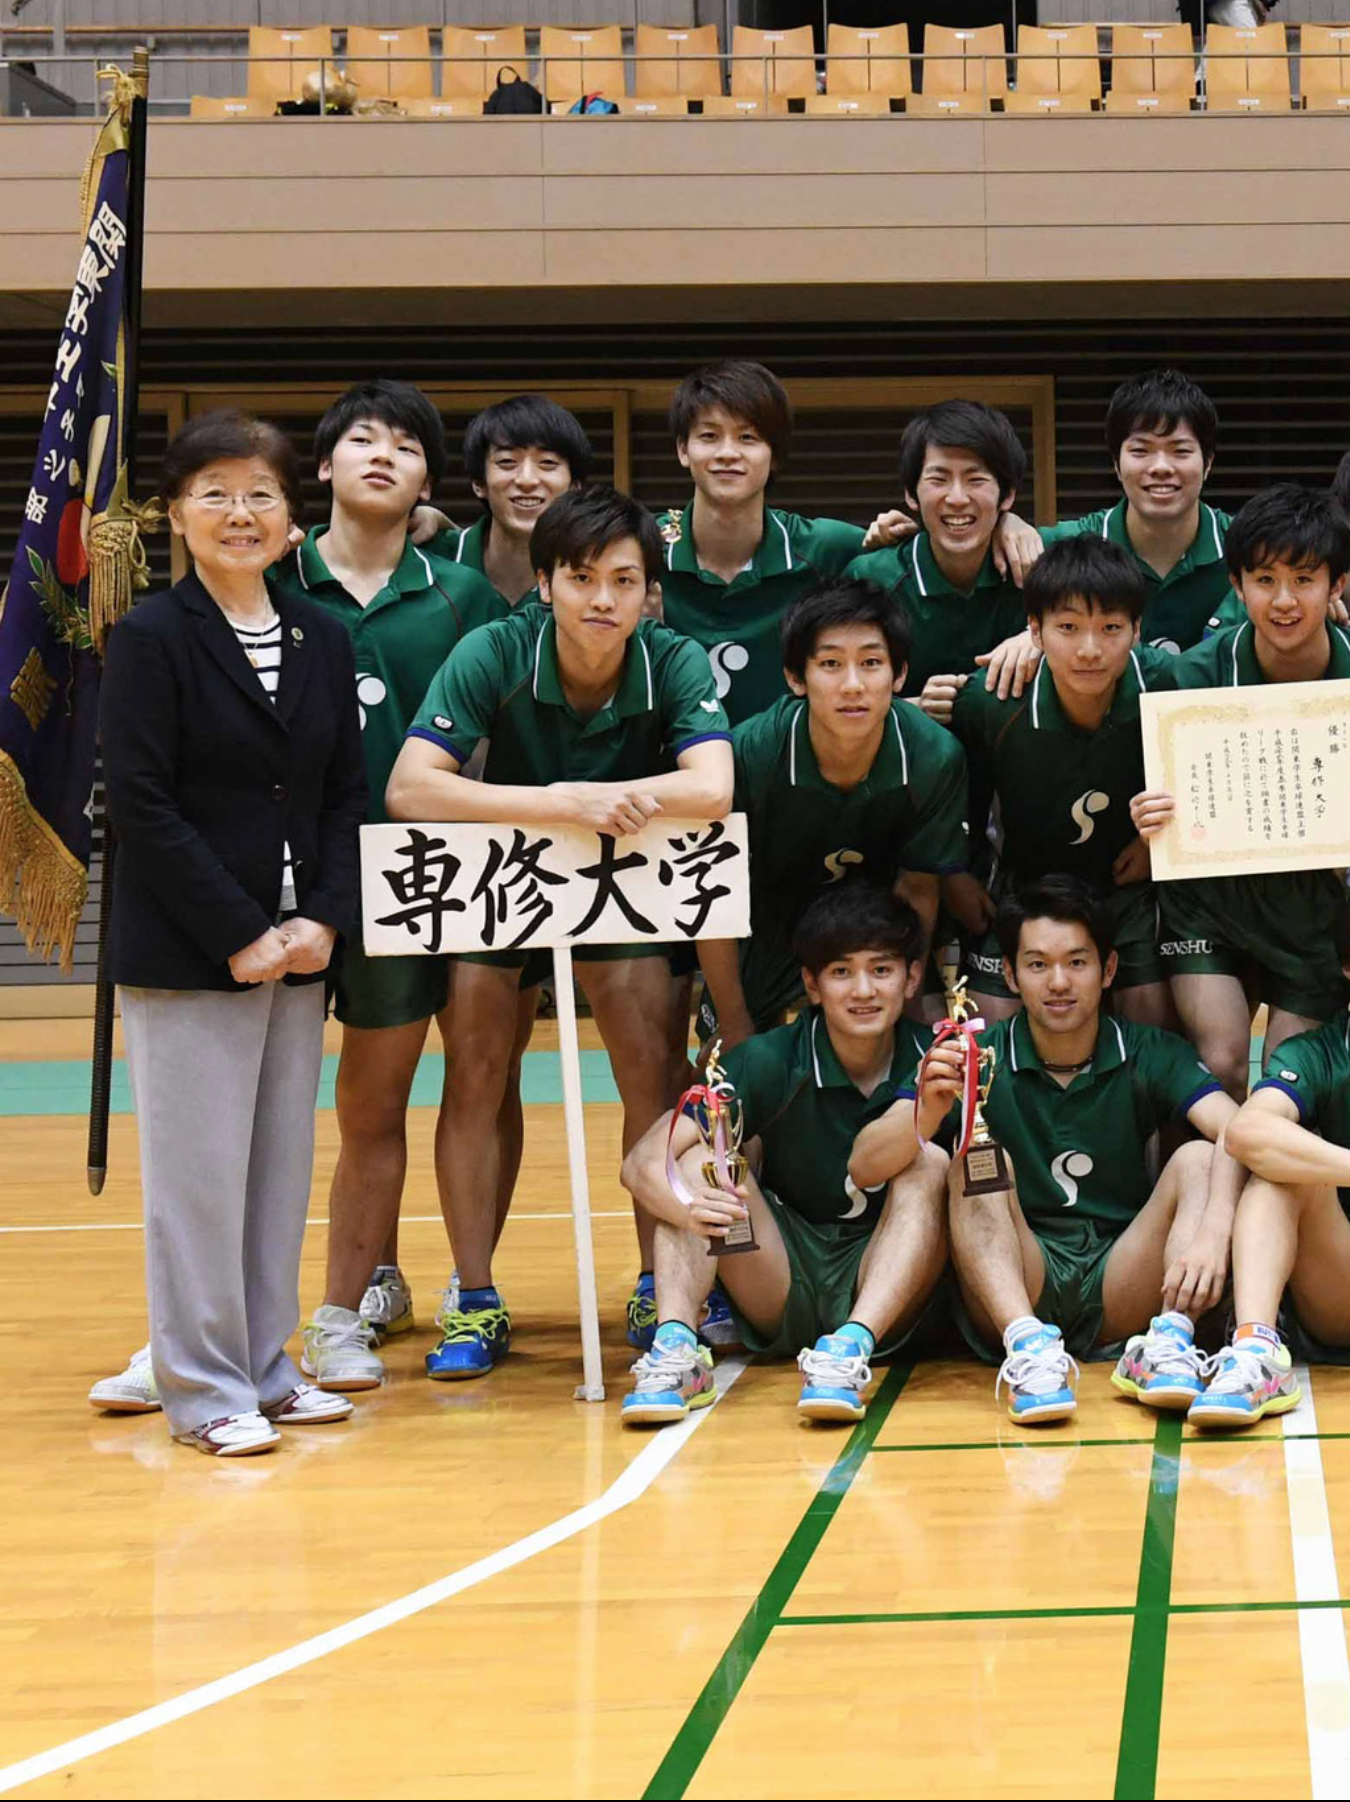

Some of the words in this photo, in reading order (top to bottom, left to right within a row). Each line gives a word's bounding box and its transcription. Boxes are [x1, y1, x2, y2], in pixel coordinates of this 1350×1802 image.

[1327, 725, 1340, 754] 優勝
[375, 821, 741, 953] 専修大学
[1160, 939, 1214, 956] SENSHU
[970, 952, 1005, 975] NSH
